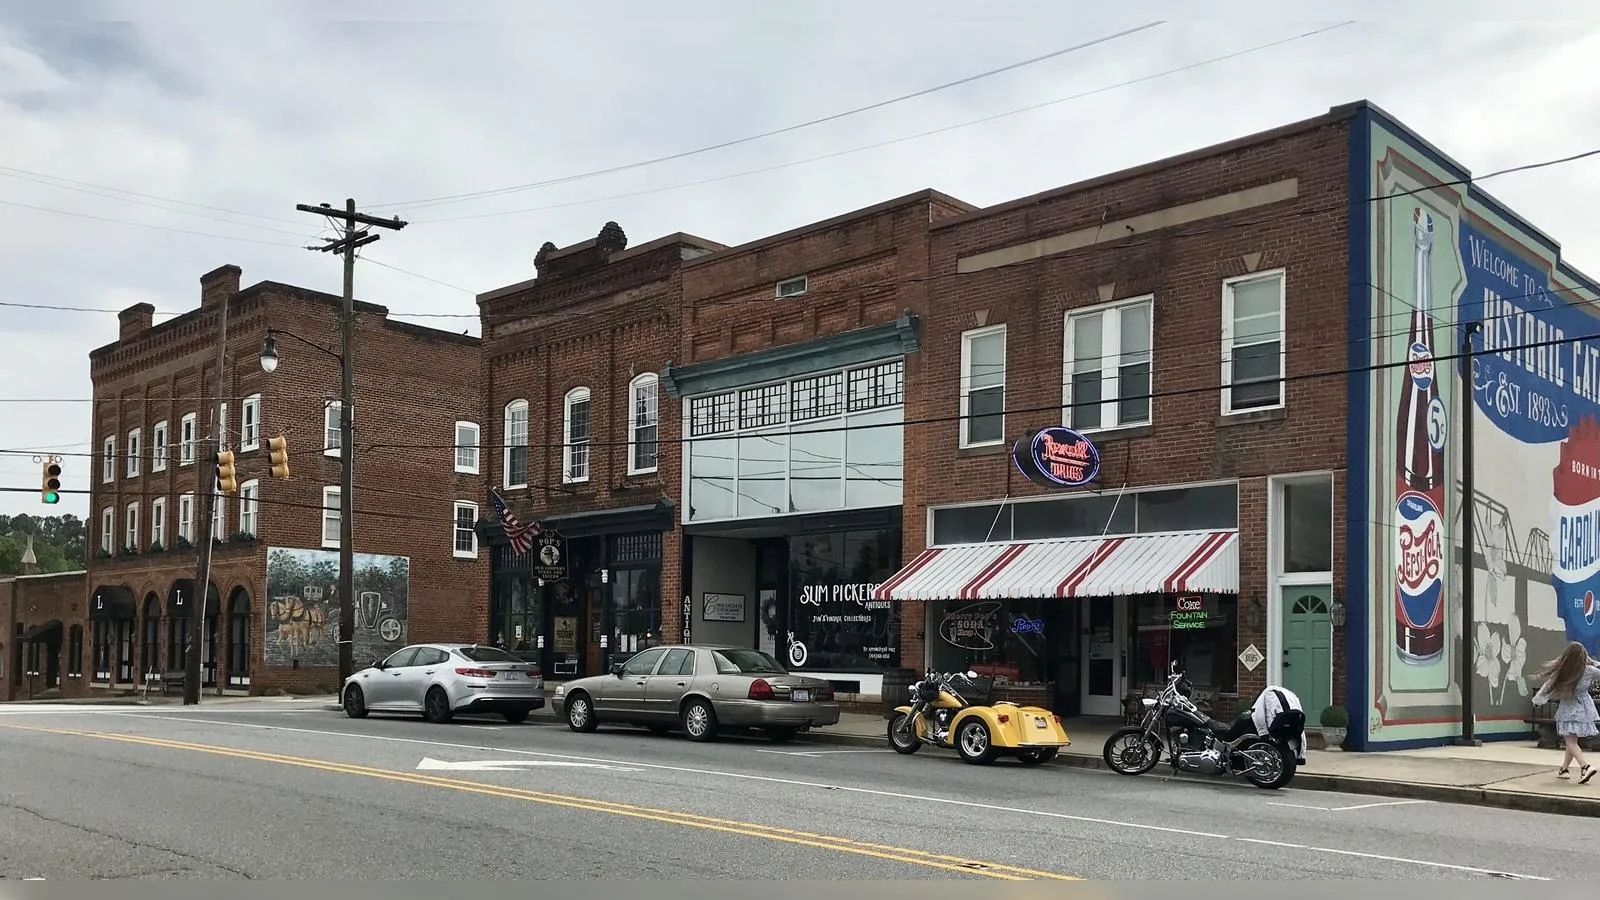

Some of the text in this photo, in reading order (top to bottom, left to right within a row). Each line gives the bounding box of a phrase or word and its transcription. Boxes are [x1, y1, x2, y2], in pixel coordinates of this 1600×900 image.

[1469, 235, 1535, 302] WELCOME TO
[1483, 287, 1564, 387] HISTORIC
[1528, 391, 1551, 427] 1893
[1050, 461, 1084, 481] DRUGS
[1571, 459, 1590, 478] BORN
[800, 584, 829, 607] SLIM
[1177, 597, 1201, 610] Coke
[865, 600, 891, 611] ANTIQUES
[957, 620, 984, 629] SODA
[1170, 611, 1208, 620] FOUNTAIN
[1173, 620, 1206, 629] SERVICE
